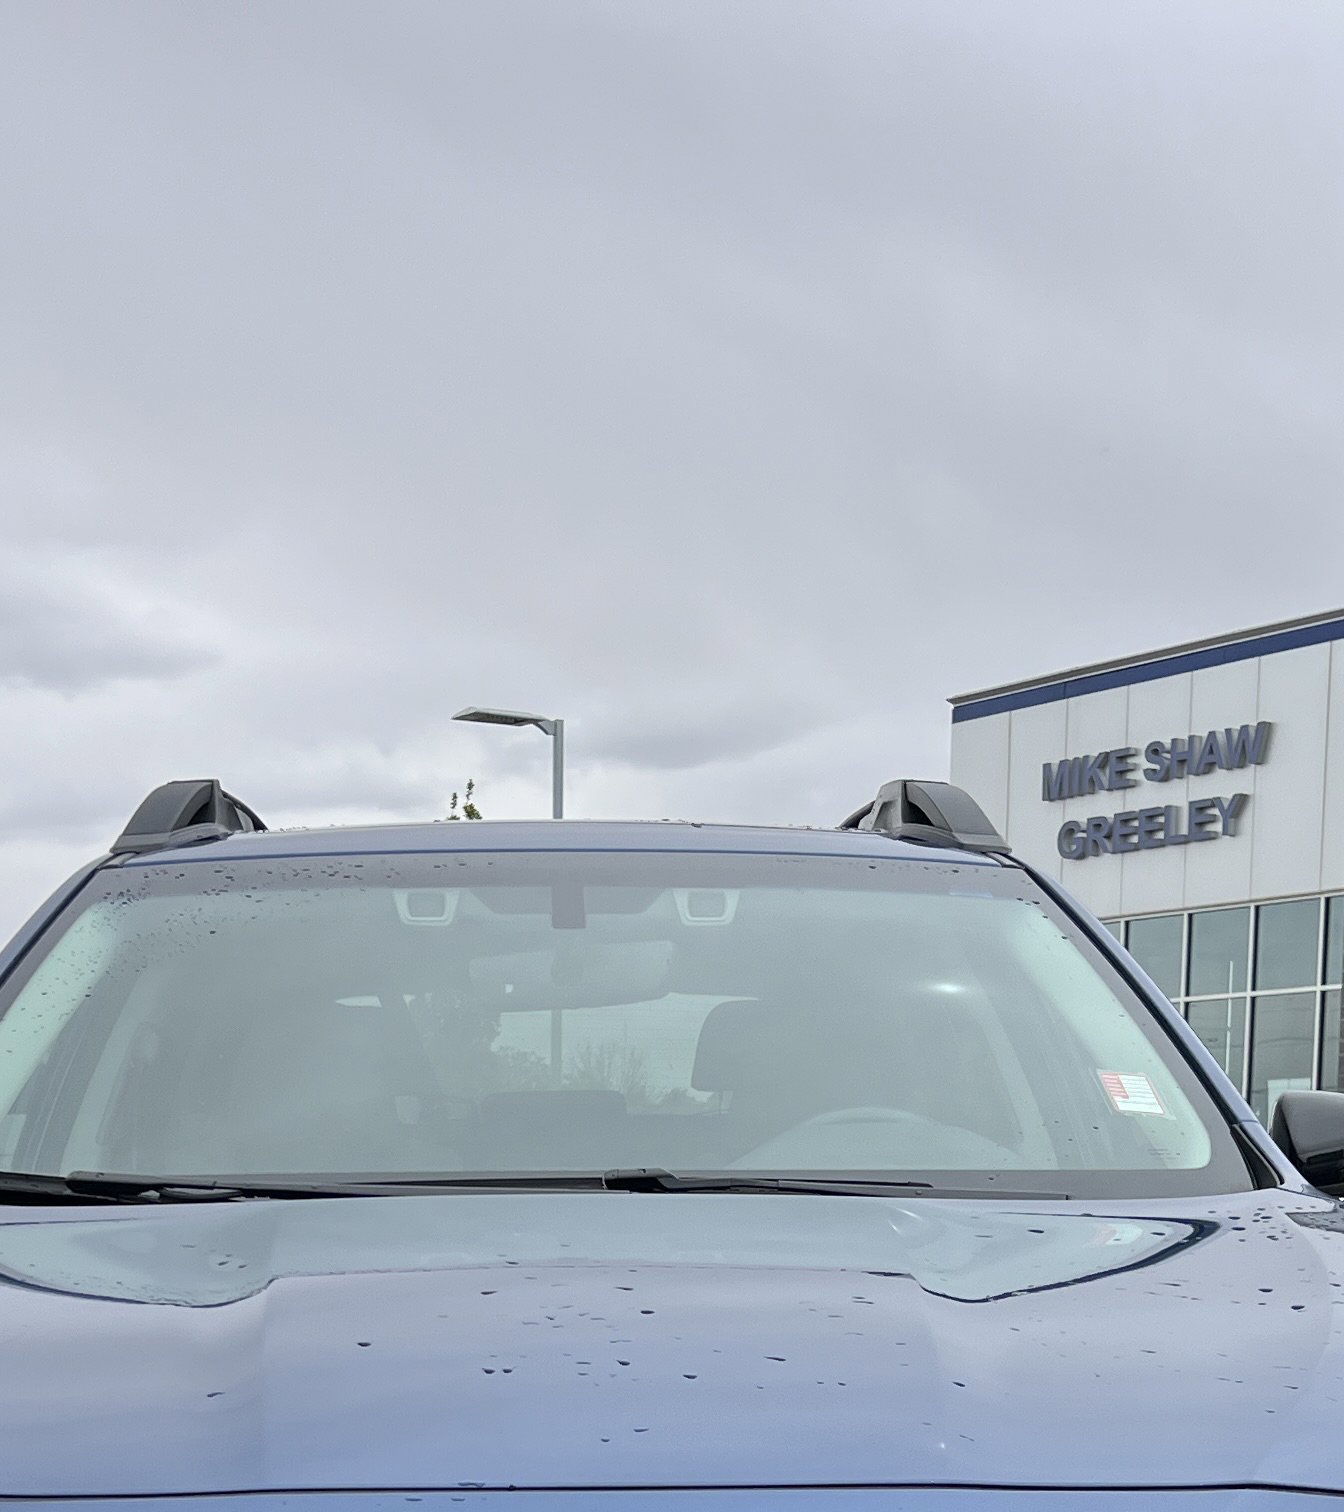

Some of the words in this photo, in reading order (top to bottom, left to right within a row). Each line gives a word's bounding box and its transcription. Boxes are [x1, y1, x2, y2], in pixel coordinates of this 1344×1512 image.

[1042, 747, 1137, 802] MIKE
[1143, 721, 1273, 782] SHAW
[1057, 793, 1249, 860] GREELEY
